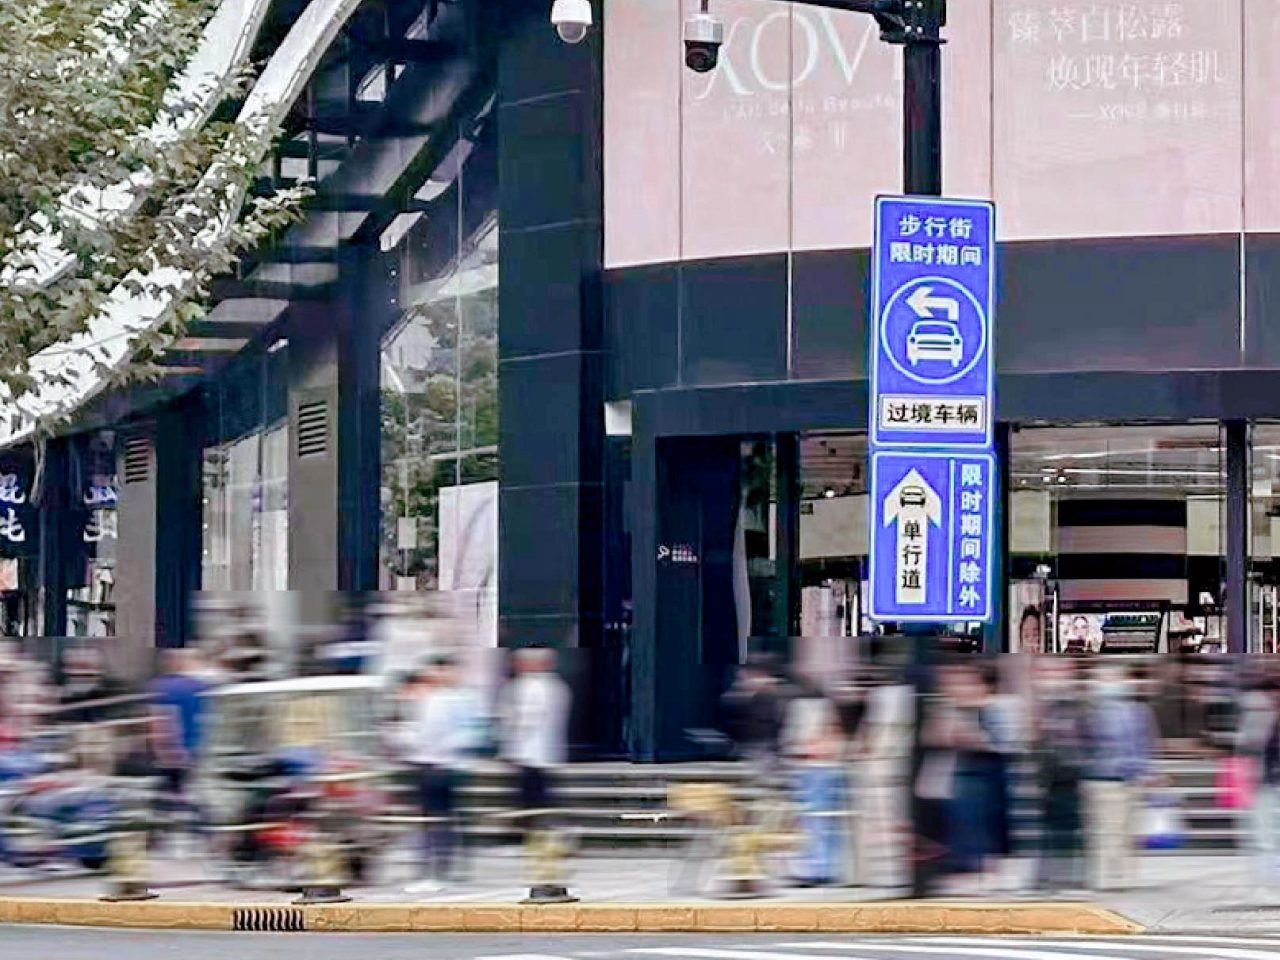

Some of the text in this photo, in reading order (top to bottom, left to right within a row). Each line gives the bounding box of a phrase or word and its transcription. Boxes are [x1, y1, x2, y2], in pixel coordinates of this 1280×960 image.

[691, 7, 904, 100] XOV
[899, 214, 973, 239] 步行街
[889, 241, 982, 266] 限时期间
[887, 402, 979, 424] 过境车辆
[902, 520, 923, 589] 单行道
[959, 463, 983, 608] 限时期间除外
